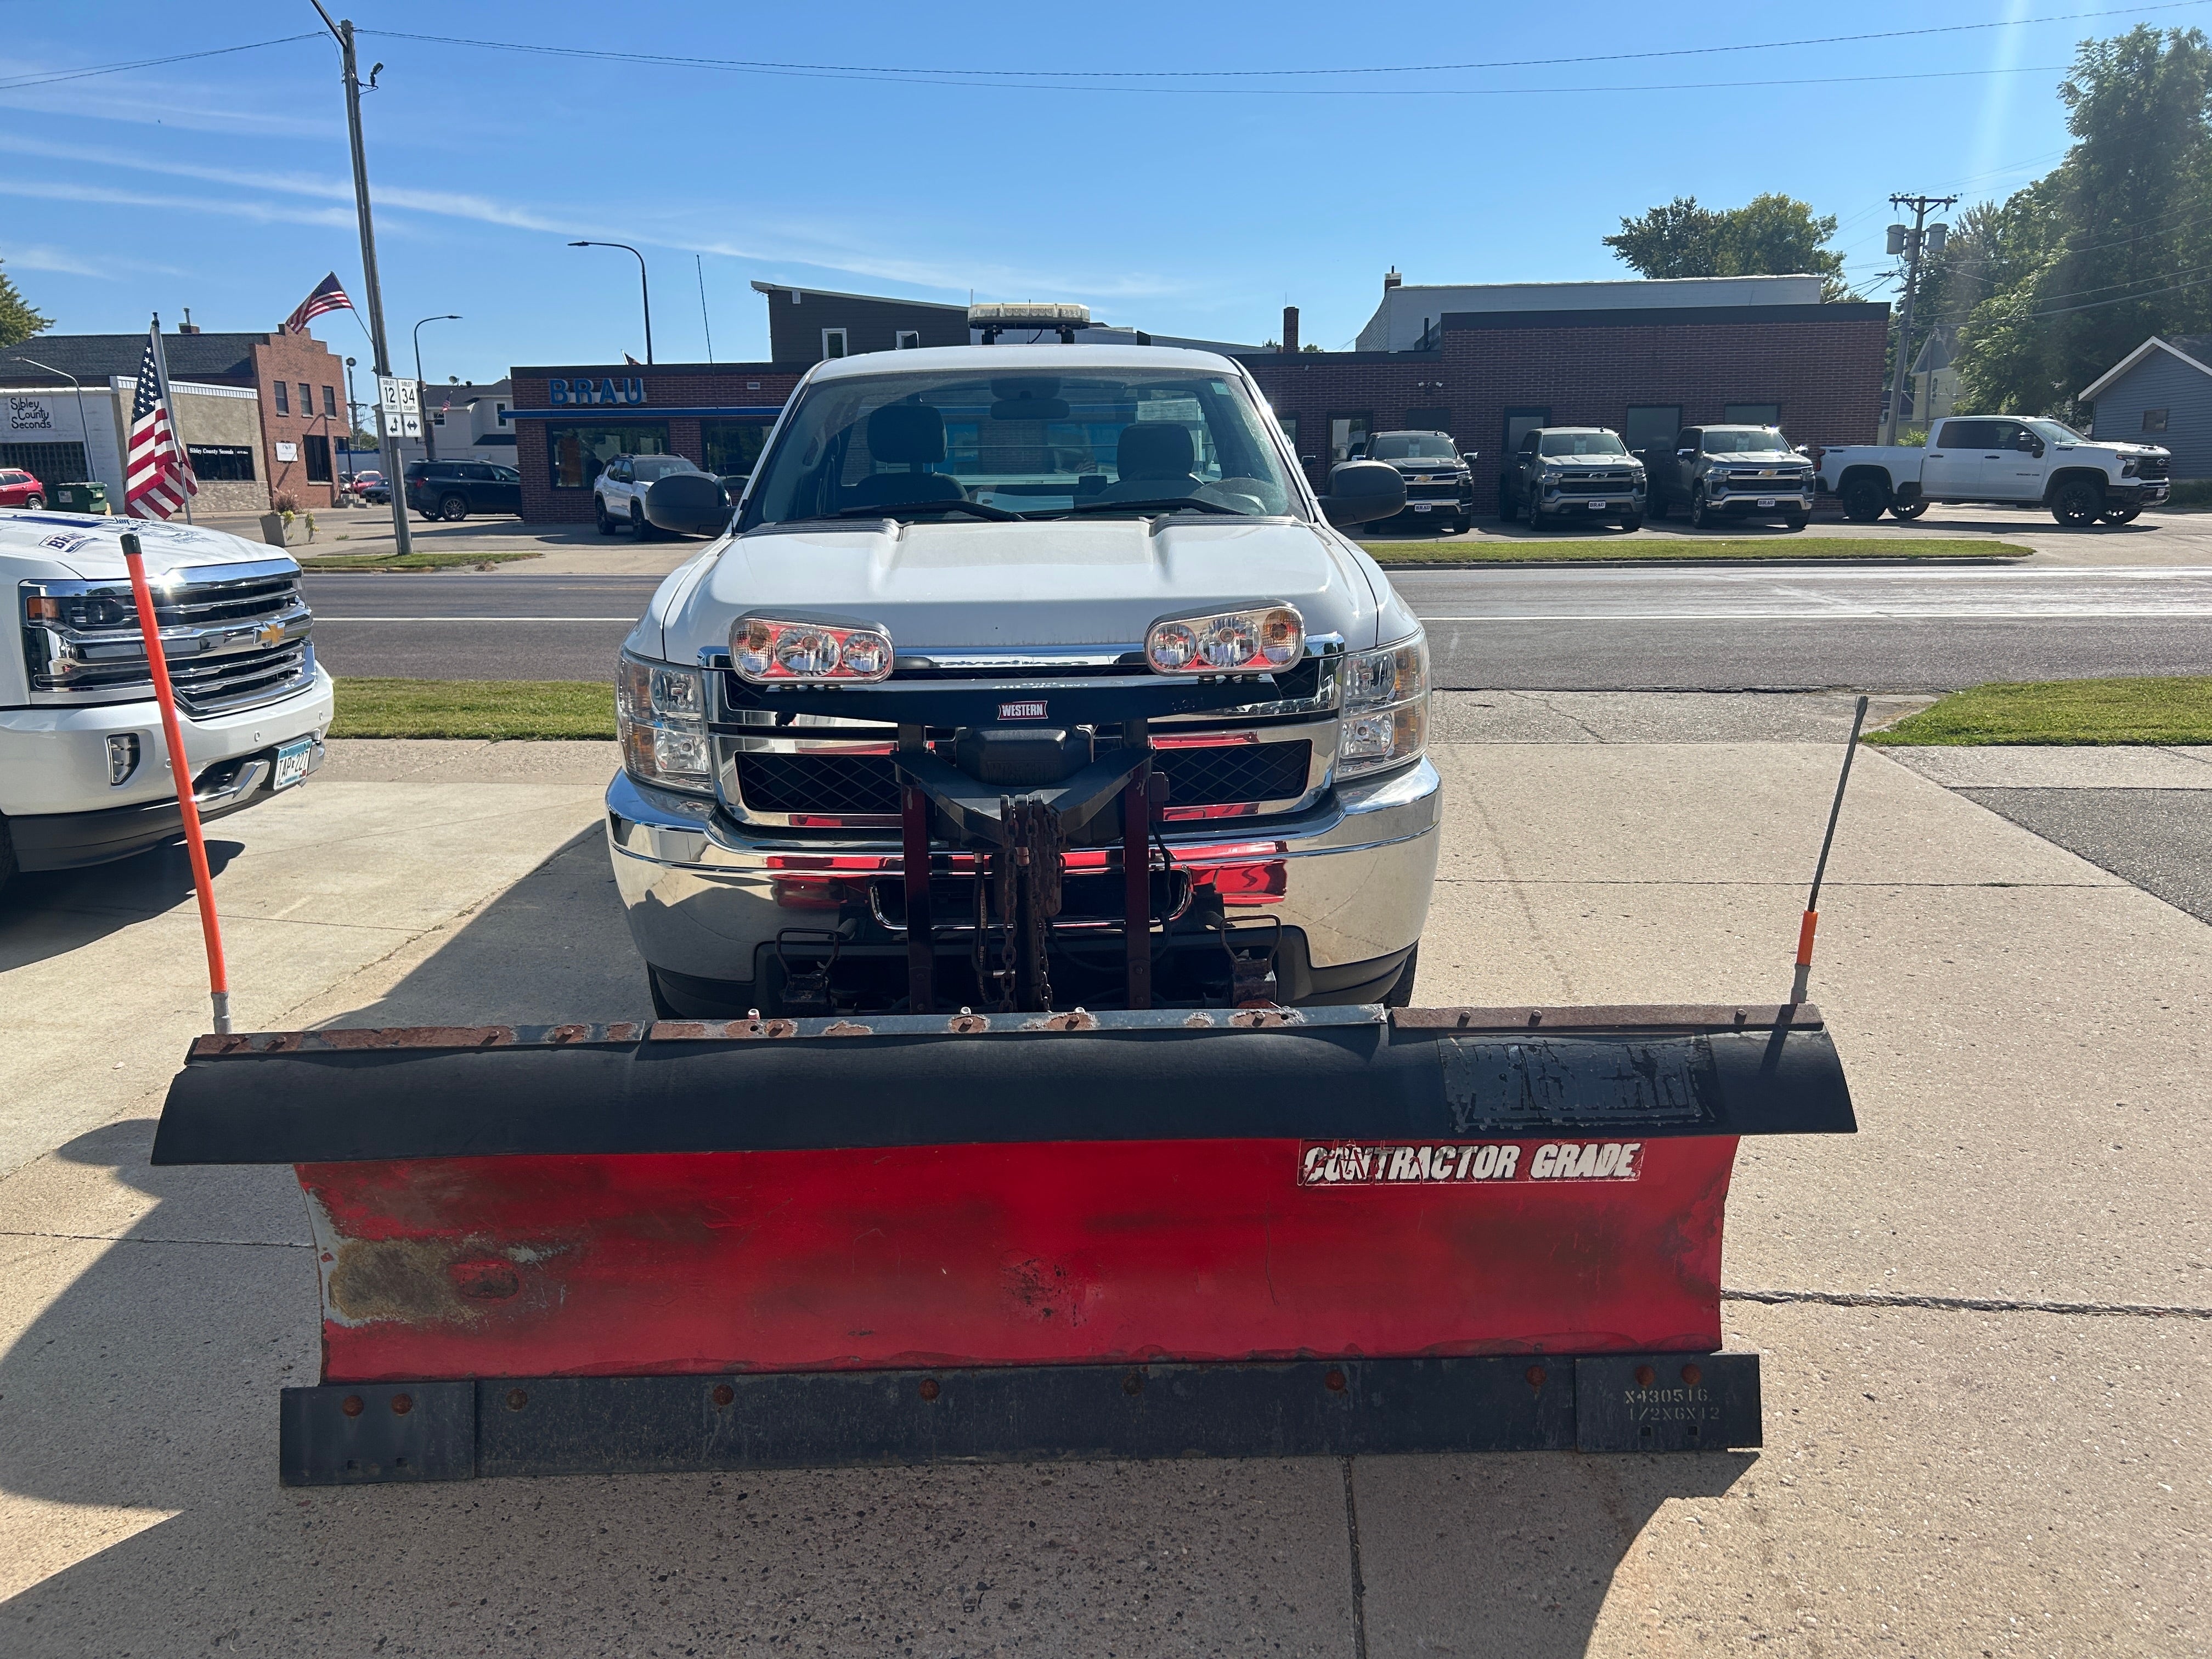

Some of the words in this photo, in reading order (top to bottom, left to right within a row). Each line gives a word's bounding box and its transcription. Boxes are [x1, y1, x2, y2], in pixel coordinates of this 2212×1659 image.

[385, 387, 396, 403] 12
[402, 388, 415, 404] 34
[549, 377, 644, 405] BRAU
[10, 397, 39, 411] Sibley
[18, 407, 49, 421] County
[12, 416, 52, 429] Seconds
[1002, 704, 1043, 716] WESTERN
[278, 757, 292, 778] TAP
[295, 750, 308, 772] 227
[1302, 1145, 1521, 1182] CONTRACTOR
[1530, 1142, 1642, 1178] GRADE
[1625, 1389, 1708, 1404] X430516
